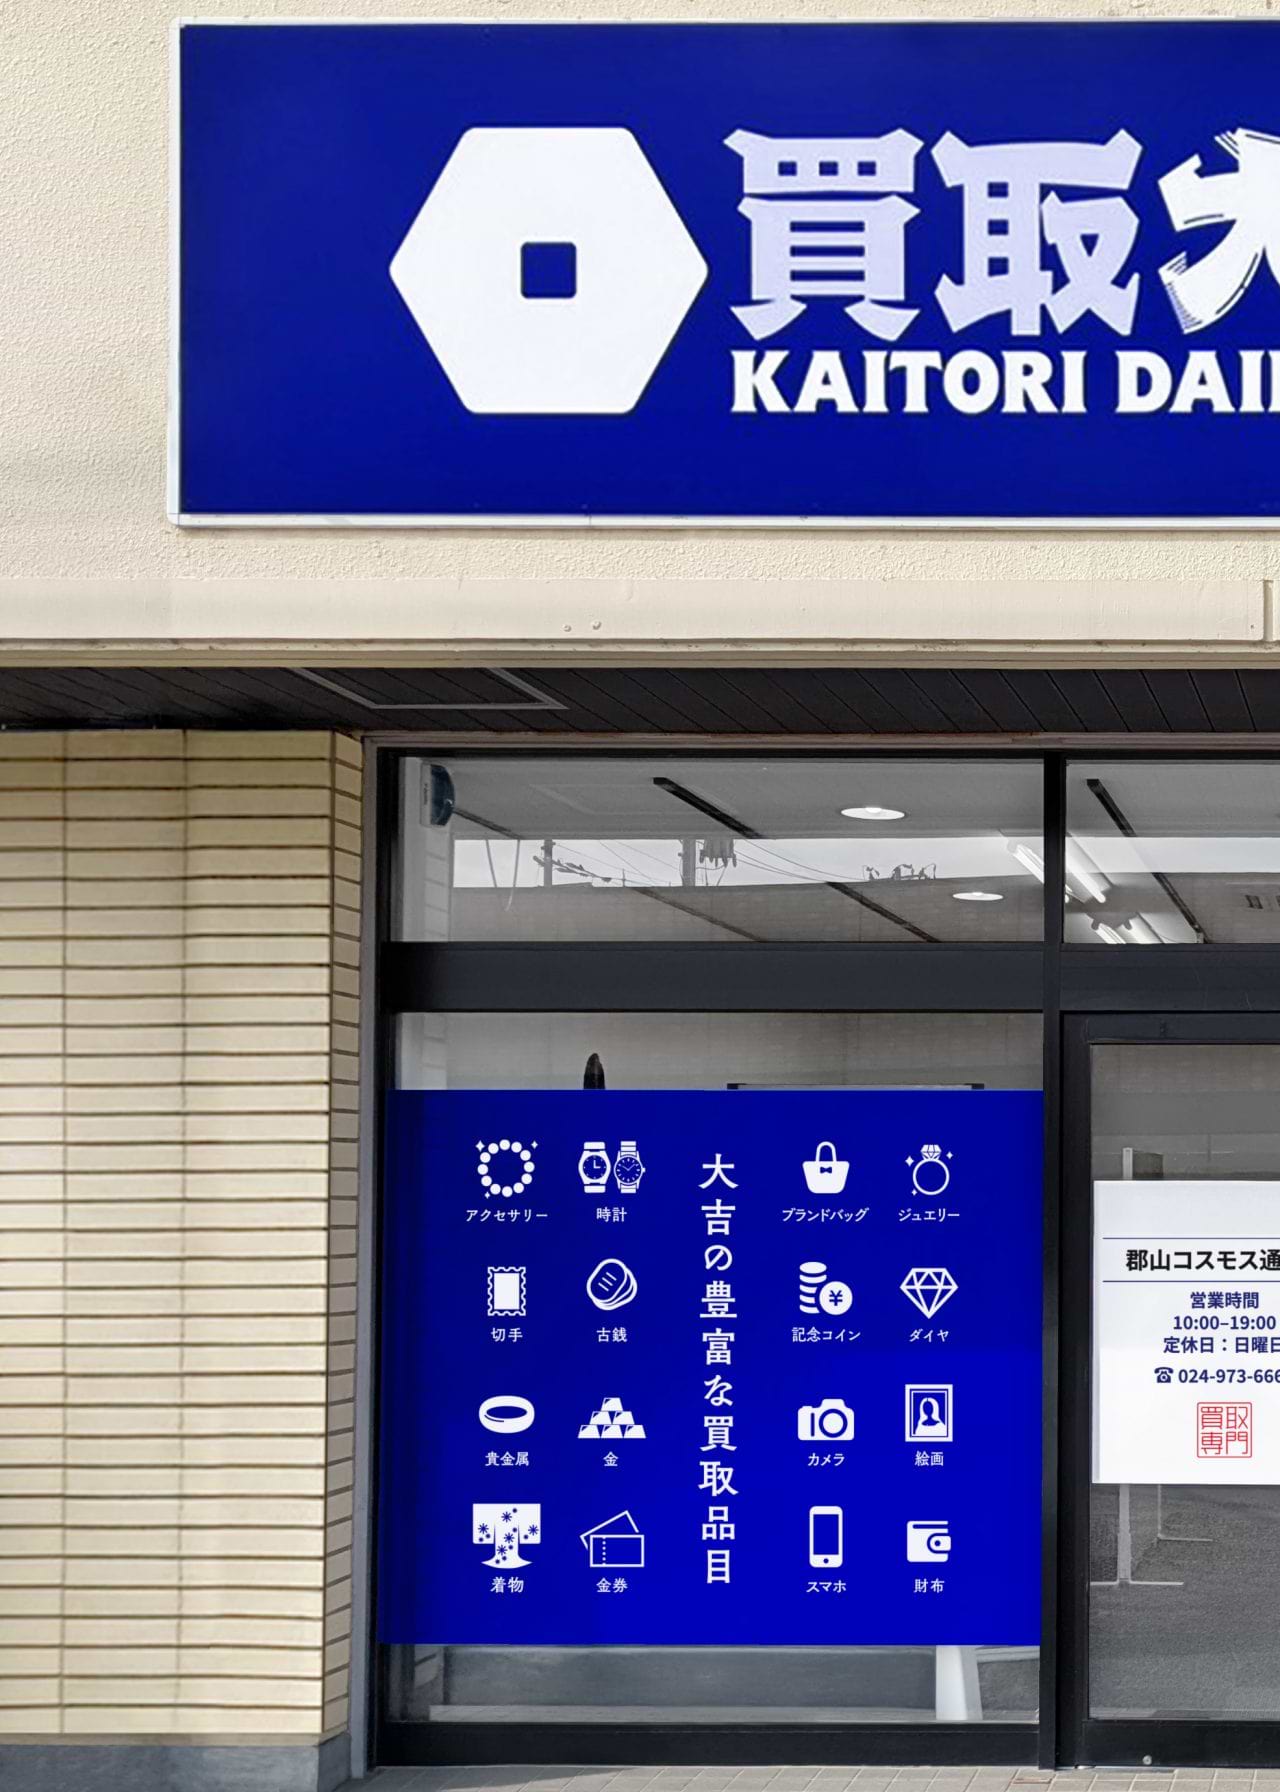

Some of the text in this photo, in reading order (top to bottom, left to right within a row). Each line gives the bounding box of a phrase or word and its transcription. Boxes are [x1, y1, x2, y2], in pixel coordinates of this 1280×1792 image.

[730, 349, 1088, 415] KAITORI
[465, 1208, 549, 1223] アクセサリー
[596, 1206, 628, 1223] 時計
[781, 1206, 870, 1223] ブランドバッグ
[897, 1208, 961, 1223] ジュエリー
[1190, 1291, 1260, 1310] 営業時間
[490, 1327, 523, 1343] 切手
[596, 1326, 628, 1343] 古銭
[791, 1326, 862, 1343] 記念コイン
[908, 1327, 950, 1343] ダイヤ
[697, 1153, 739, 1584] 大吉の豊富な買取品目
[484, 1450, 530, 1467] 貴金属
[602, 1450, 620, 1467] 金
[807, 1452, 846, 1467] カメラ
[914, 1450, 945, 1467] 絵画
[490, 1576, 525, 1594] 着物
[596, 1577, 629, 1593] 金券
[806, 1579, 848, 1593] スマホ
[913, 1577, 945, 1593] 財布
